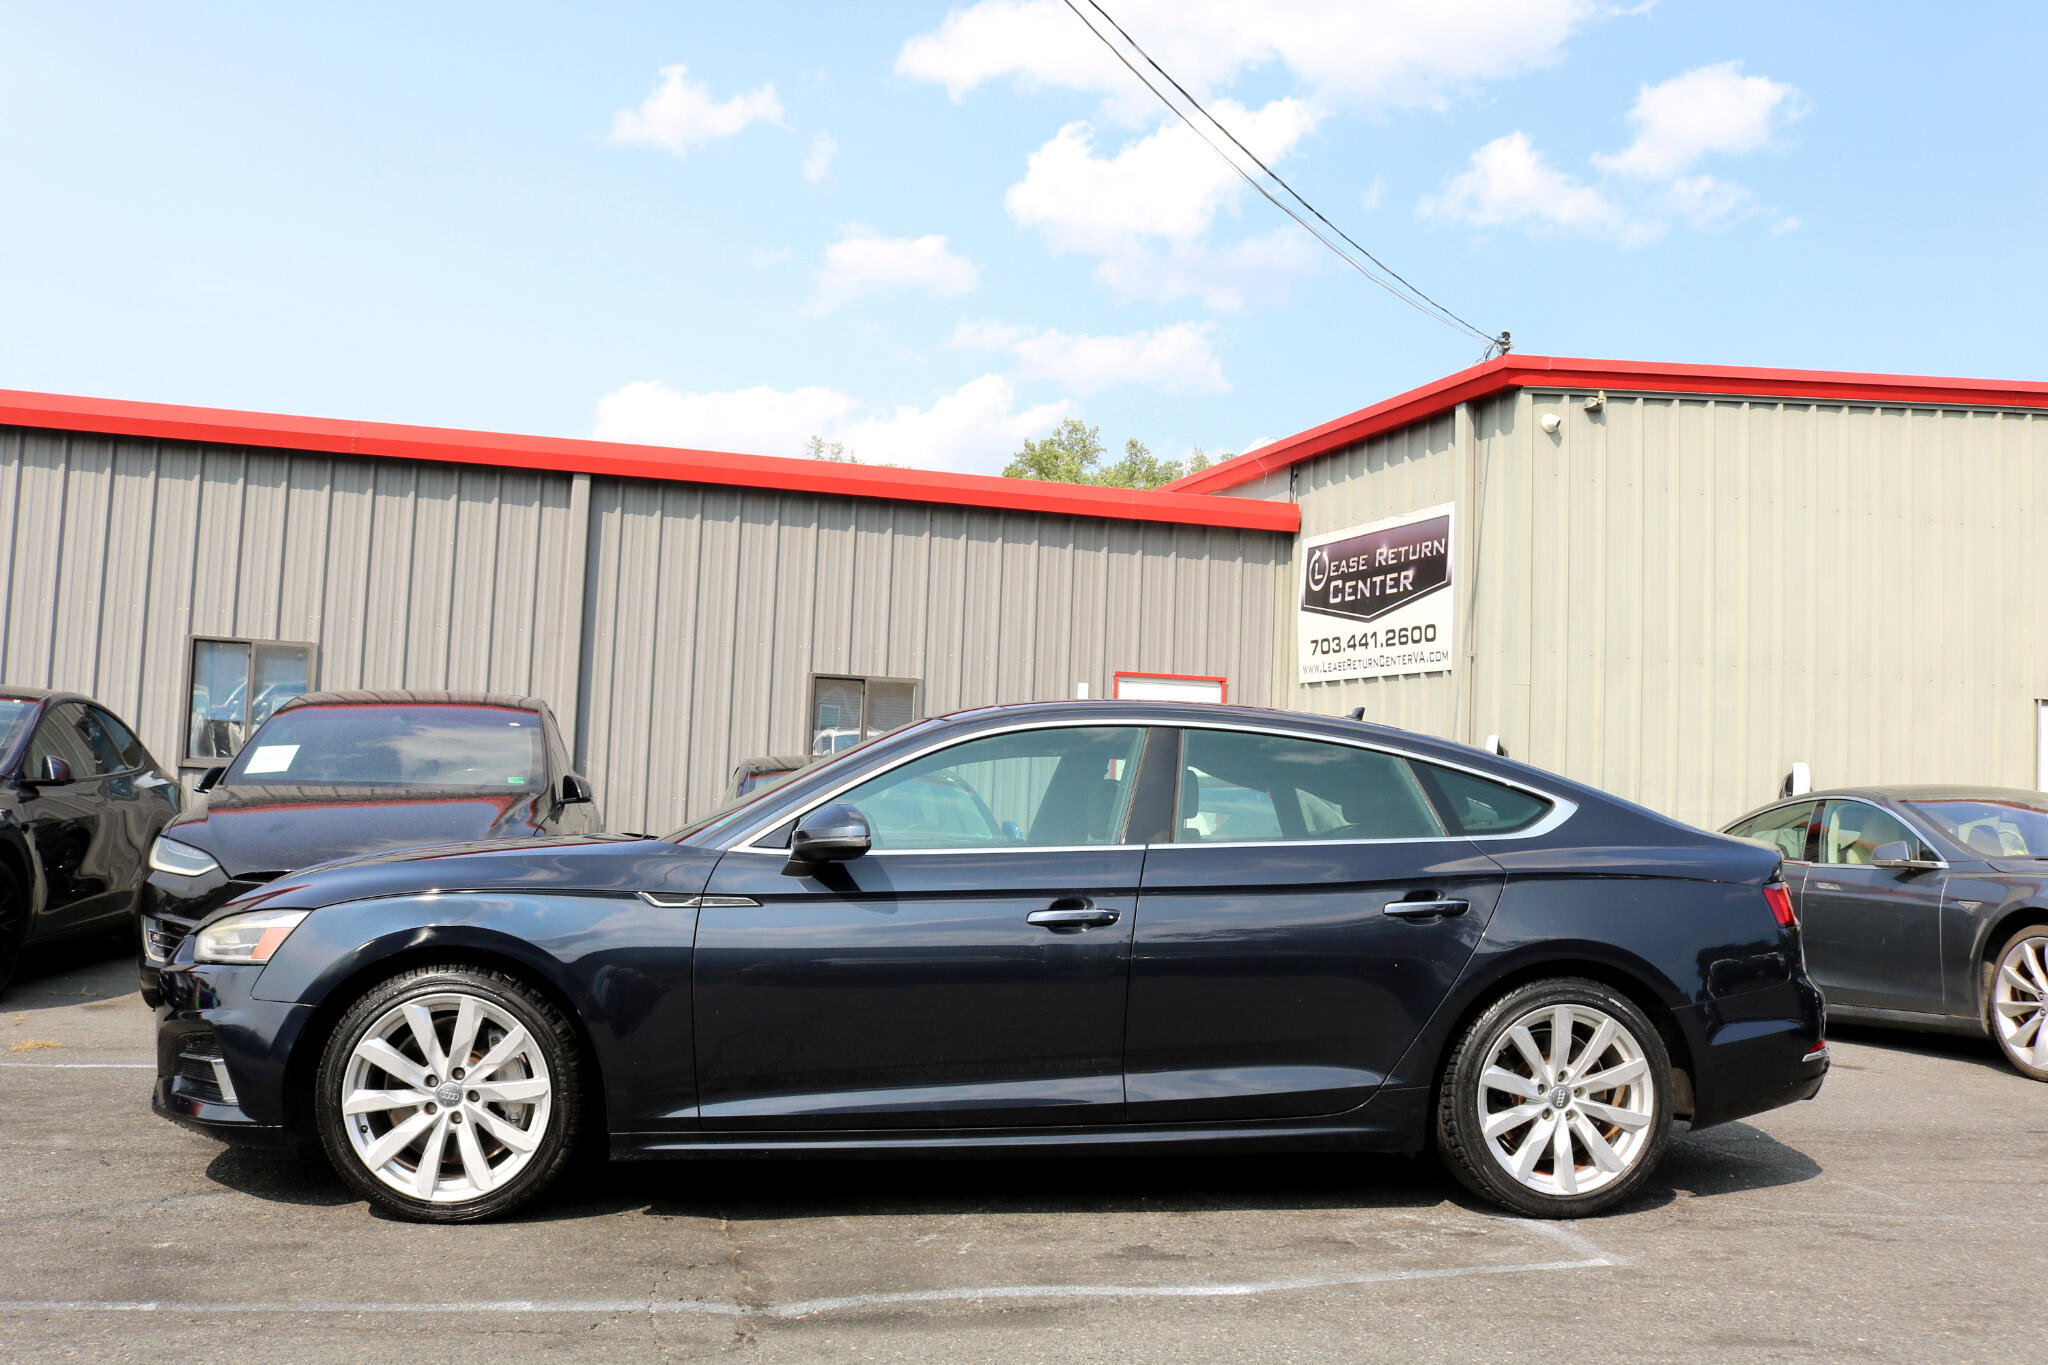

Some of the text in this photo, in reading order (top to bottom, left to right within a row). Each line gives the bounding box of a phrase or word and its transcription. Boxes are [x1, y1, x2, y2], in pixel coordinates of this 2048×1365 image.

[1375, 538, 1445, 568] RETURN
[1329, 569, 1414, 604] CENTER
[1310, 623, 1437, 656] 703.441.2600
